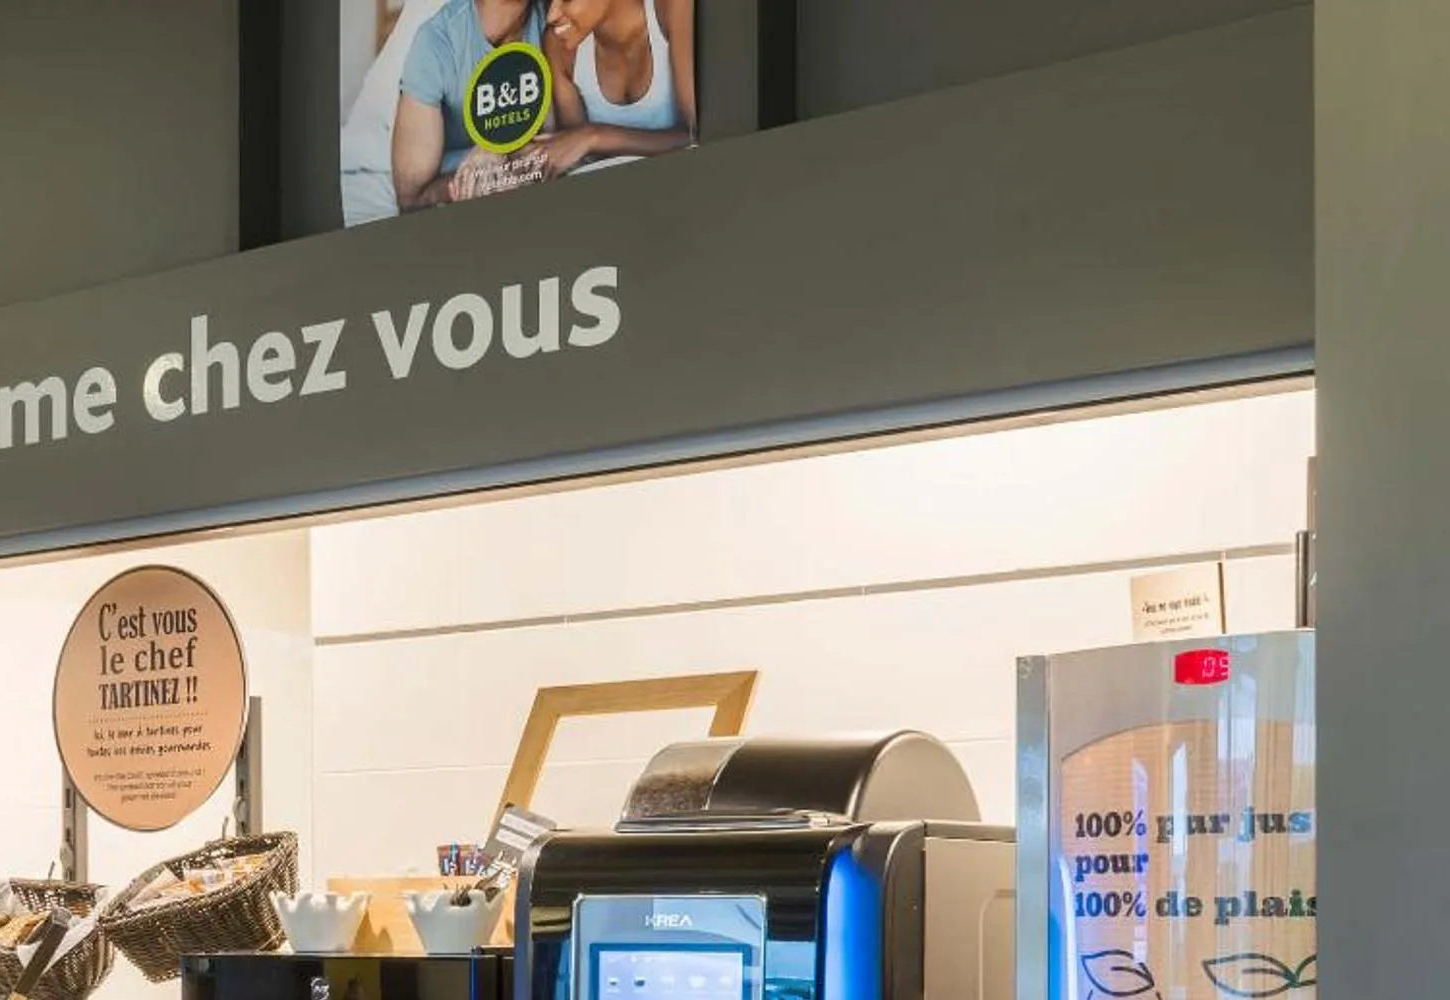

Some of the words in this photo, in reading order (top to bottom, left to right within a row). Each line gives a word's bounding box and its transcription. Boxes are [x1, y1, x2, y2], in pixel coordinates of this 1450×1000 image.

[476, 72, 540, 116] B&B
[484, 107, 531, 130] HOTELS
[143, 314, 347, 422] chez
[372, 265, 622, 380] vous
[99, 602, 147, 641] C'est
[152, 607, 198, 636] vous
[100, 645, 125, 676] le
[134, 636, 199, 672] chef
[98, 677, 180, 710] TARTINEZ
[186, 676, 199, 703] !!
[1075, 809, 1147, 838] 100%
[1156, 812, 1230, 844] pur
[1237, 806, 1313, 843] jus
[1074, 852, 1149, 883] pour
[1074, 891, 1147, 918] 100%
[1156, 890, 1204, 918] de
